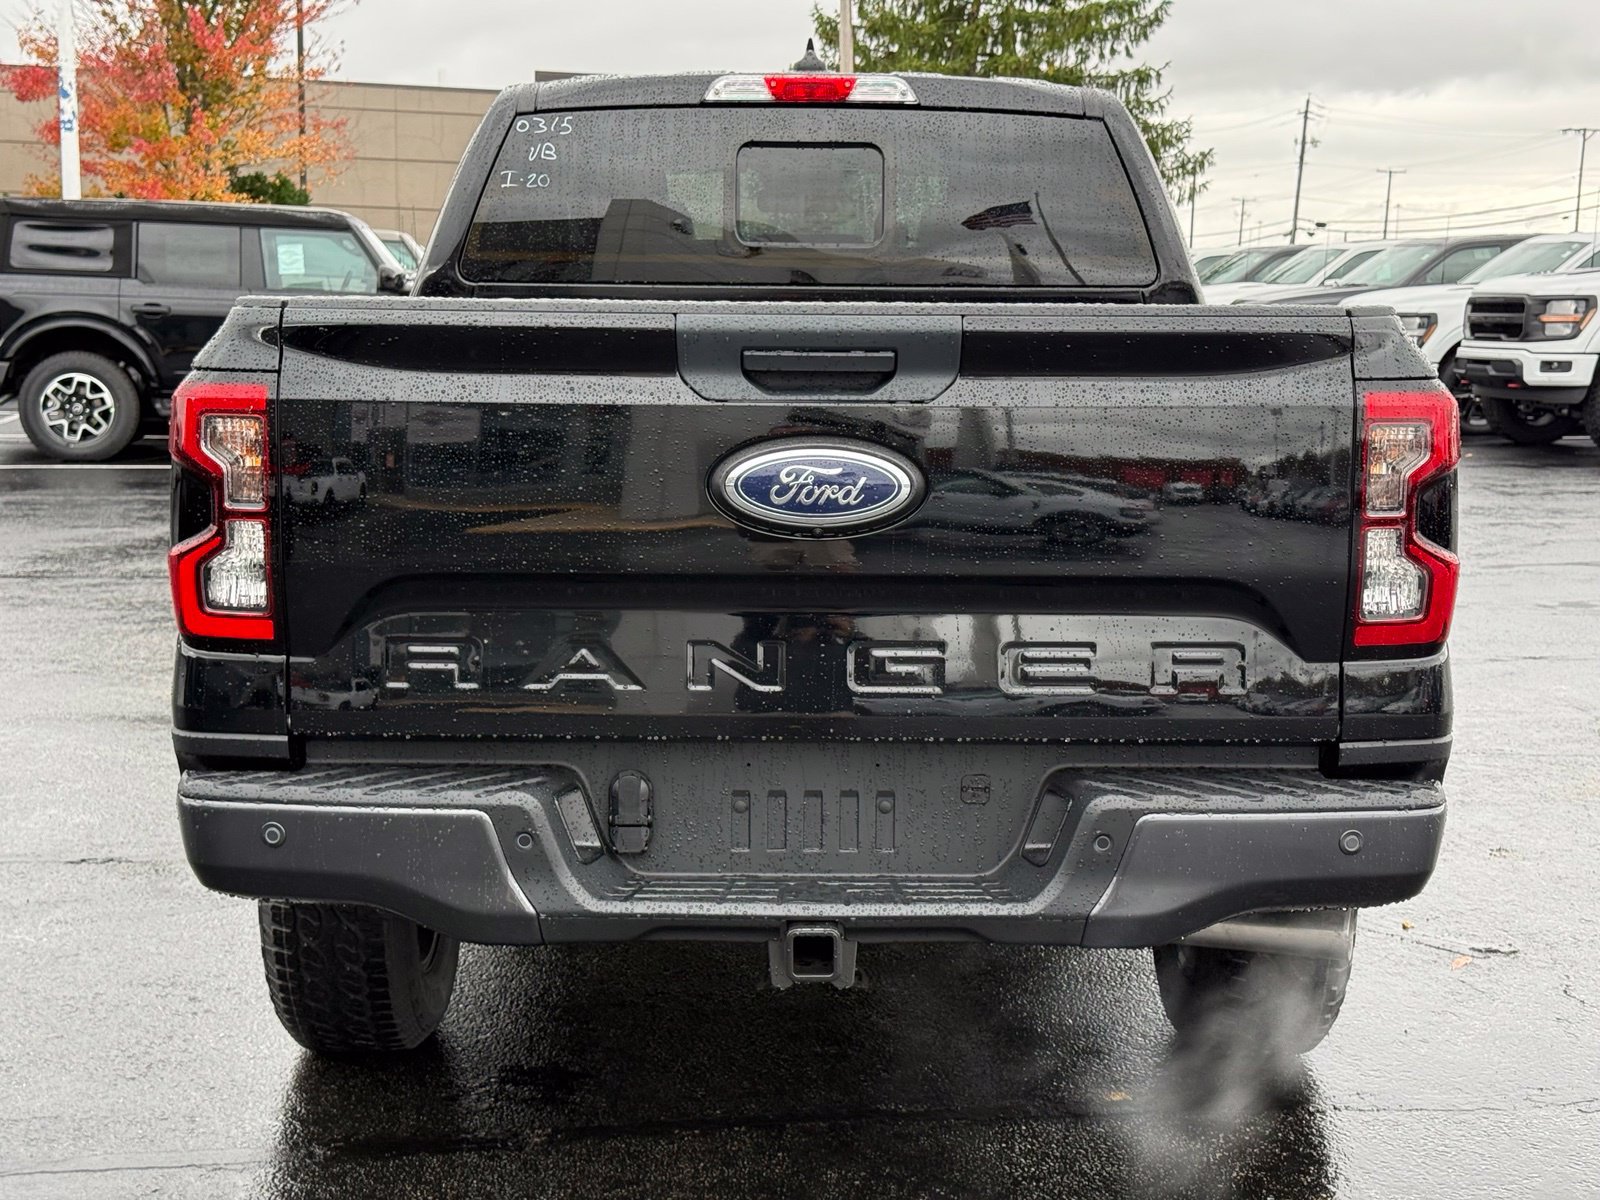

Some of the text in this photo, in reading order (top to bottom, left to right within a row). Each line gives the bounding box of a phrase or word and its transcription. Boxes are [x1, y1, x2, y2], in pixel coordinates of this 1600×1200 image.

[516, 116, 573, 135] 0315
[769, 464, 867, 506] Ford
[384, 634, 1248, 697] RANGER
